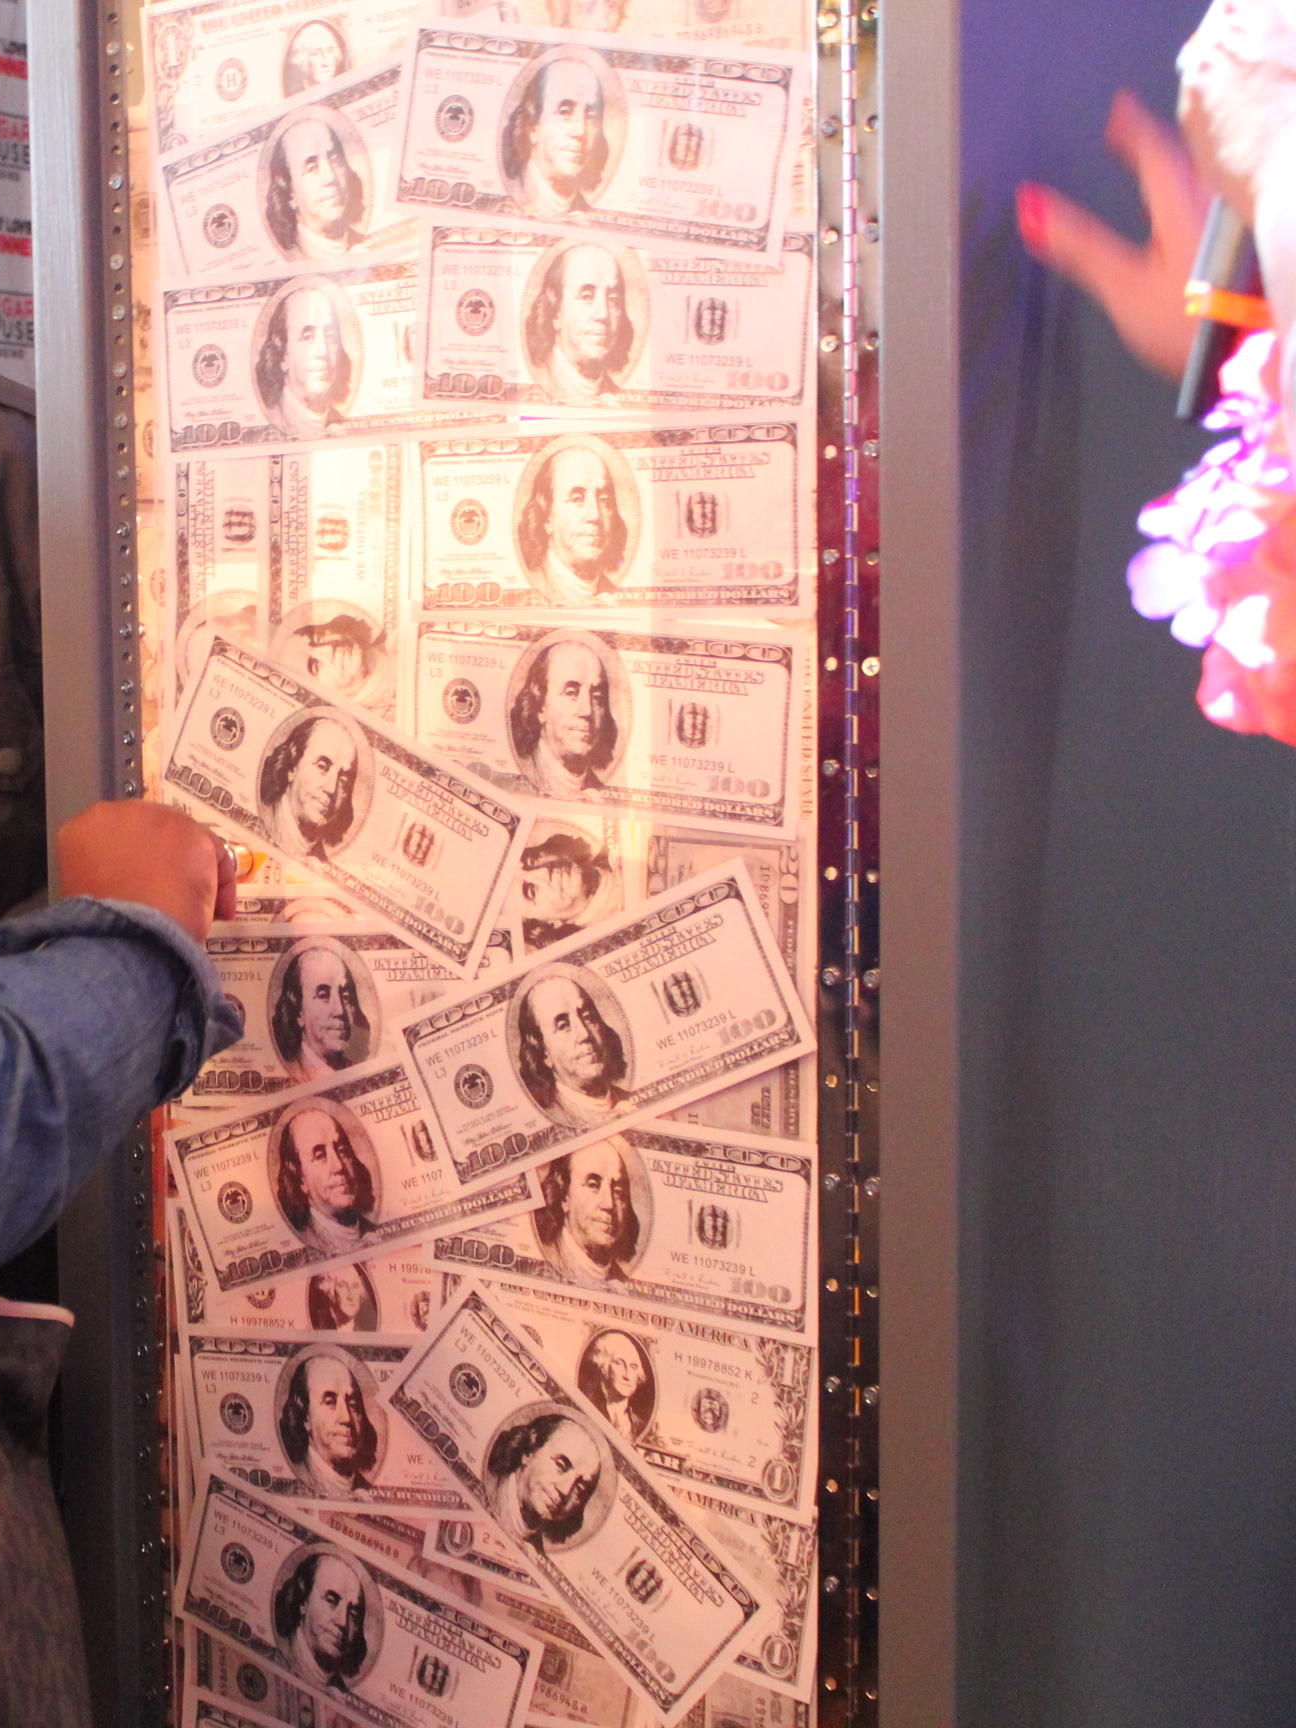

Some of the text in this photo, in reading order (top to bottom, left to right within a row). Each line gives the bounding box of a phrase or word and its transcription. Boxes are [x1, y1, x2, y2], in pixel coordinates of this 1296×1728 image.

[660, 548, 680, 559] WE
[683, 547, 736, 558] 11073239
[720, 561, 783, 580] 100
[436, 582, 502, 603] 100
[427, 652, 445, 663] WE
[448, 654, 497, 668] 11073239
[211, 672, 228, 689] WE
[228, 683, 270, 714] 11073239
[649, 753, 668, 765] WE
[671, 757, 723, 771] 11073239
[175, 762, 236, 813] 100
[708, 775, 769, 798] 100
[371, 850, 389, 868] WE
[389, 862, 434, 896] 11073239
[411, 892, 466, 937] 100
[655, 1033, 676, 1050] WE
[676, 1011, 727, 1041] 11073239
[716, 1006, 778, 1047] 100
[425, 1052, 443, 1067] WE
[444, 1031, 490, 1059] 11073239
[193, 1166, 210, 1179] WE
[210, 1152, 253, 1173] 11073239
[464, 1129, 531, 1174] 100
[401, 1168, 443, 1189] WE 1107
[223, 1248, 285, 1282] 100
[446, 1233, 517, 1268] 100
[671, 1250, 689, 1263] WE
[694, 1254, 744, 1274] 11073239
[731, 1275, 789, 1305] 100
[677, 1321, 752, 1351] AMERICA
[459, 1325, 476, 1345] WE
[475, 1344, 516, 1390] 11073239
[674, 1351, 683, 1362] H
[745, 1369, 753, 1380] K
[201, 1370, 217, 1379] WE
[219, 1371, 262, 1382] 11073239
[402, 1395, 462, 1464] 100
[408, 1454, 426, 1464] WE
[213, 1509, 229, 1525] WE
[231, 1519, 274, 1550] 11073239
[590, 1566, 609, 1588] WE
[606, 1585, 650, 1635] 11073239
[623, 1625, 678, 1686] 100
